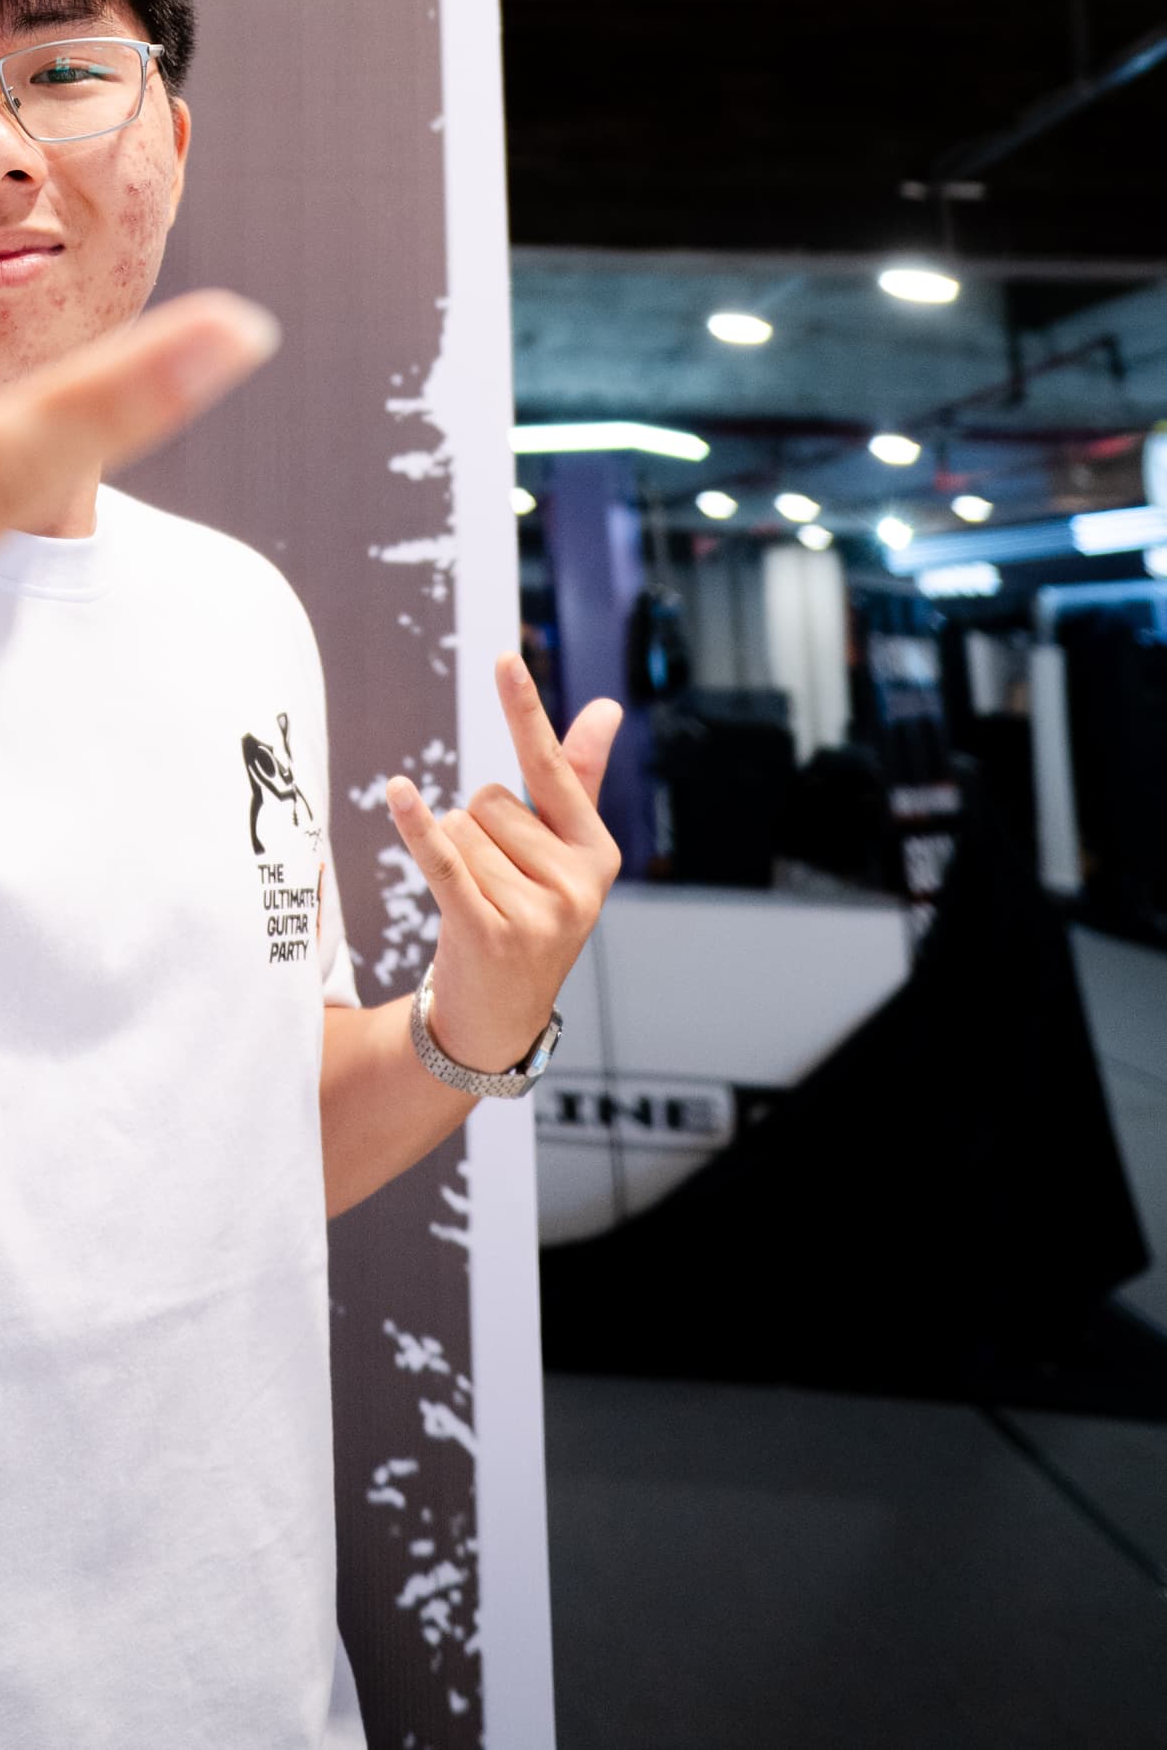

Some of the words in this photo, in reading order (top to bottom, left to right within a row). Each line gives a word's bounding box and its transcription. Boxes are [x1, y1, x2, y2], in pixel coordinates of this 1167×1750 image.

[258, 863, 285, 884] THE
[263, 887, 315, 911] ULTIMATE
[267, 913, 309, 937] GUITAR
[269, 940, 309, 964] PARTY
